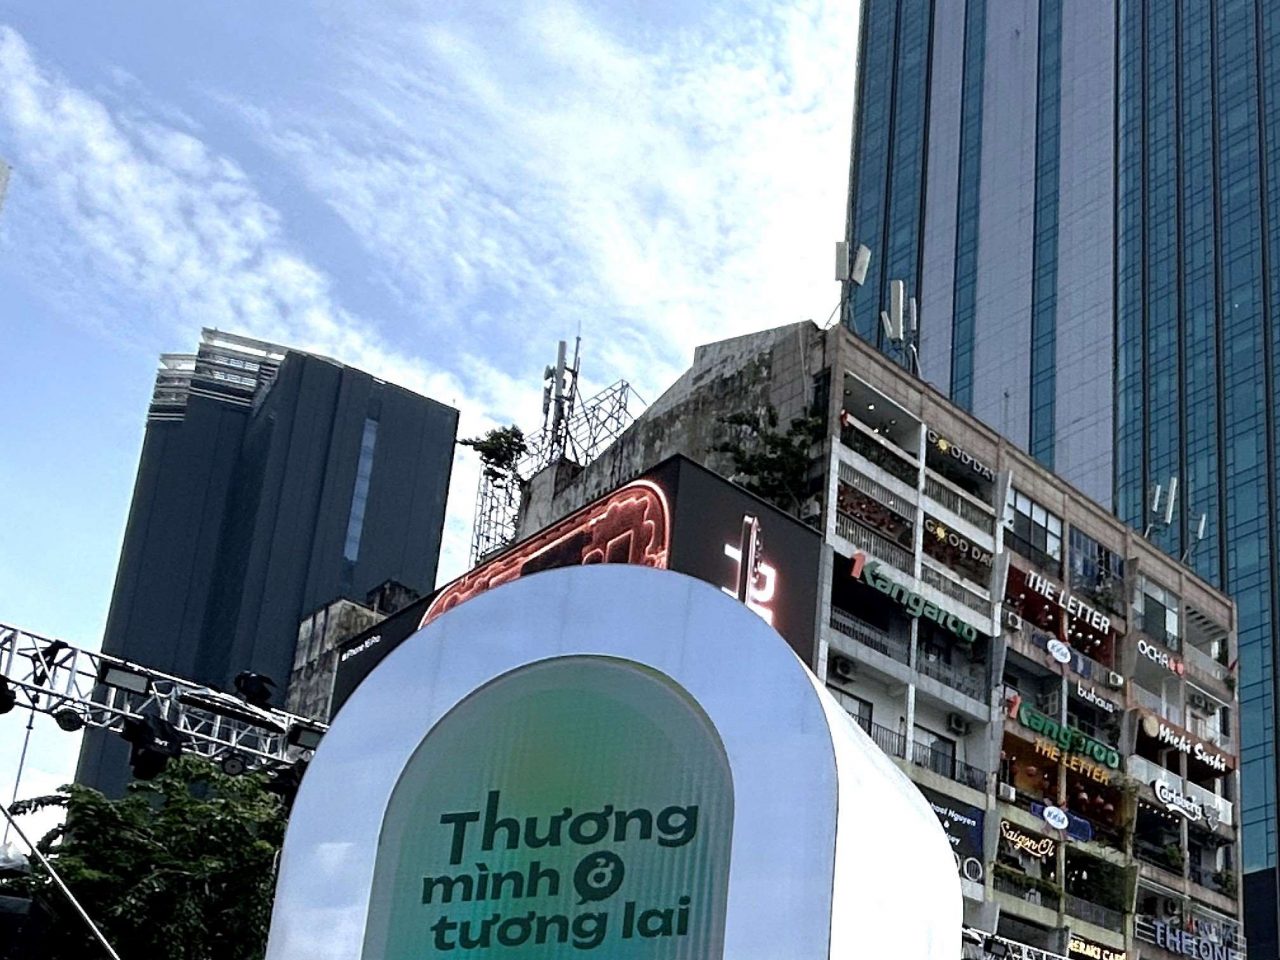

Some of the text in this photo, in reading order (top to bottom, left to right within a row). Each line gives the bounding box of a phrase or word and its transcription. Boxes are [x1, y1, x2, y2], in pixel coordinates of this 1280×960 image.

[973, 458, 996, 482] DAY
[971, 549, 993, 568] DAY
[851, 550, 978, 642] Kangaroo
[1028, 570, 1111, 635] THE LETTER
[1008, 695, 1120, 769] Kangaroo
[1158, 723, 1226, 773] Michi Sushi
[1034, 738, 1110, 787] THE LETTER
[1154, 777, 1204, 822] Carlsberg
[440, 789, 699, 865] Thương
[1001, 820, 1038, 852] Saigon
[421, 861, 560, 905] mình
[430, 896, 692, 951] tương lai
[1152, 919, 1196, 956] THE
